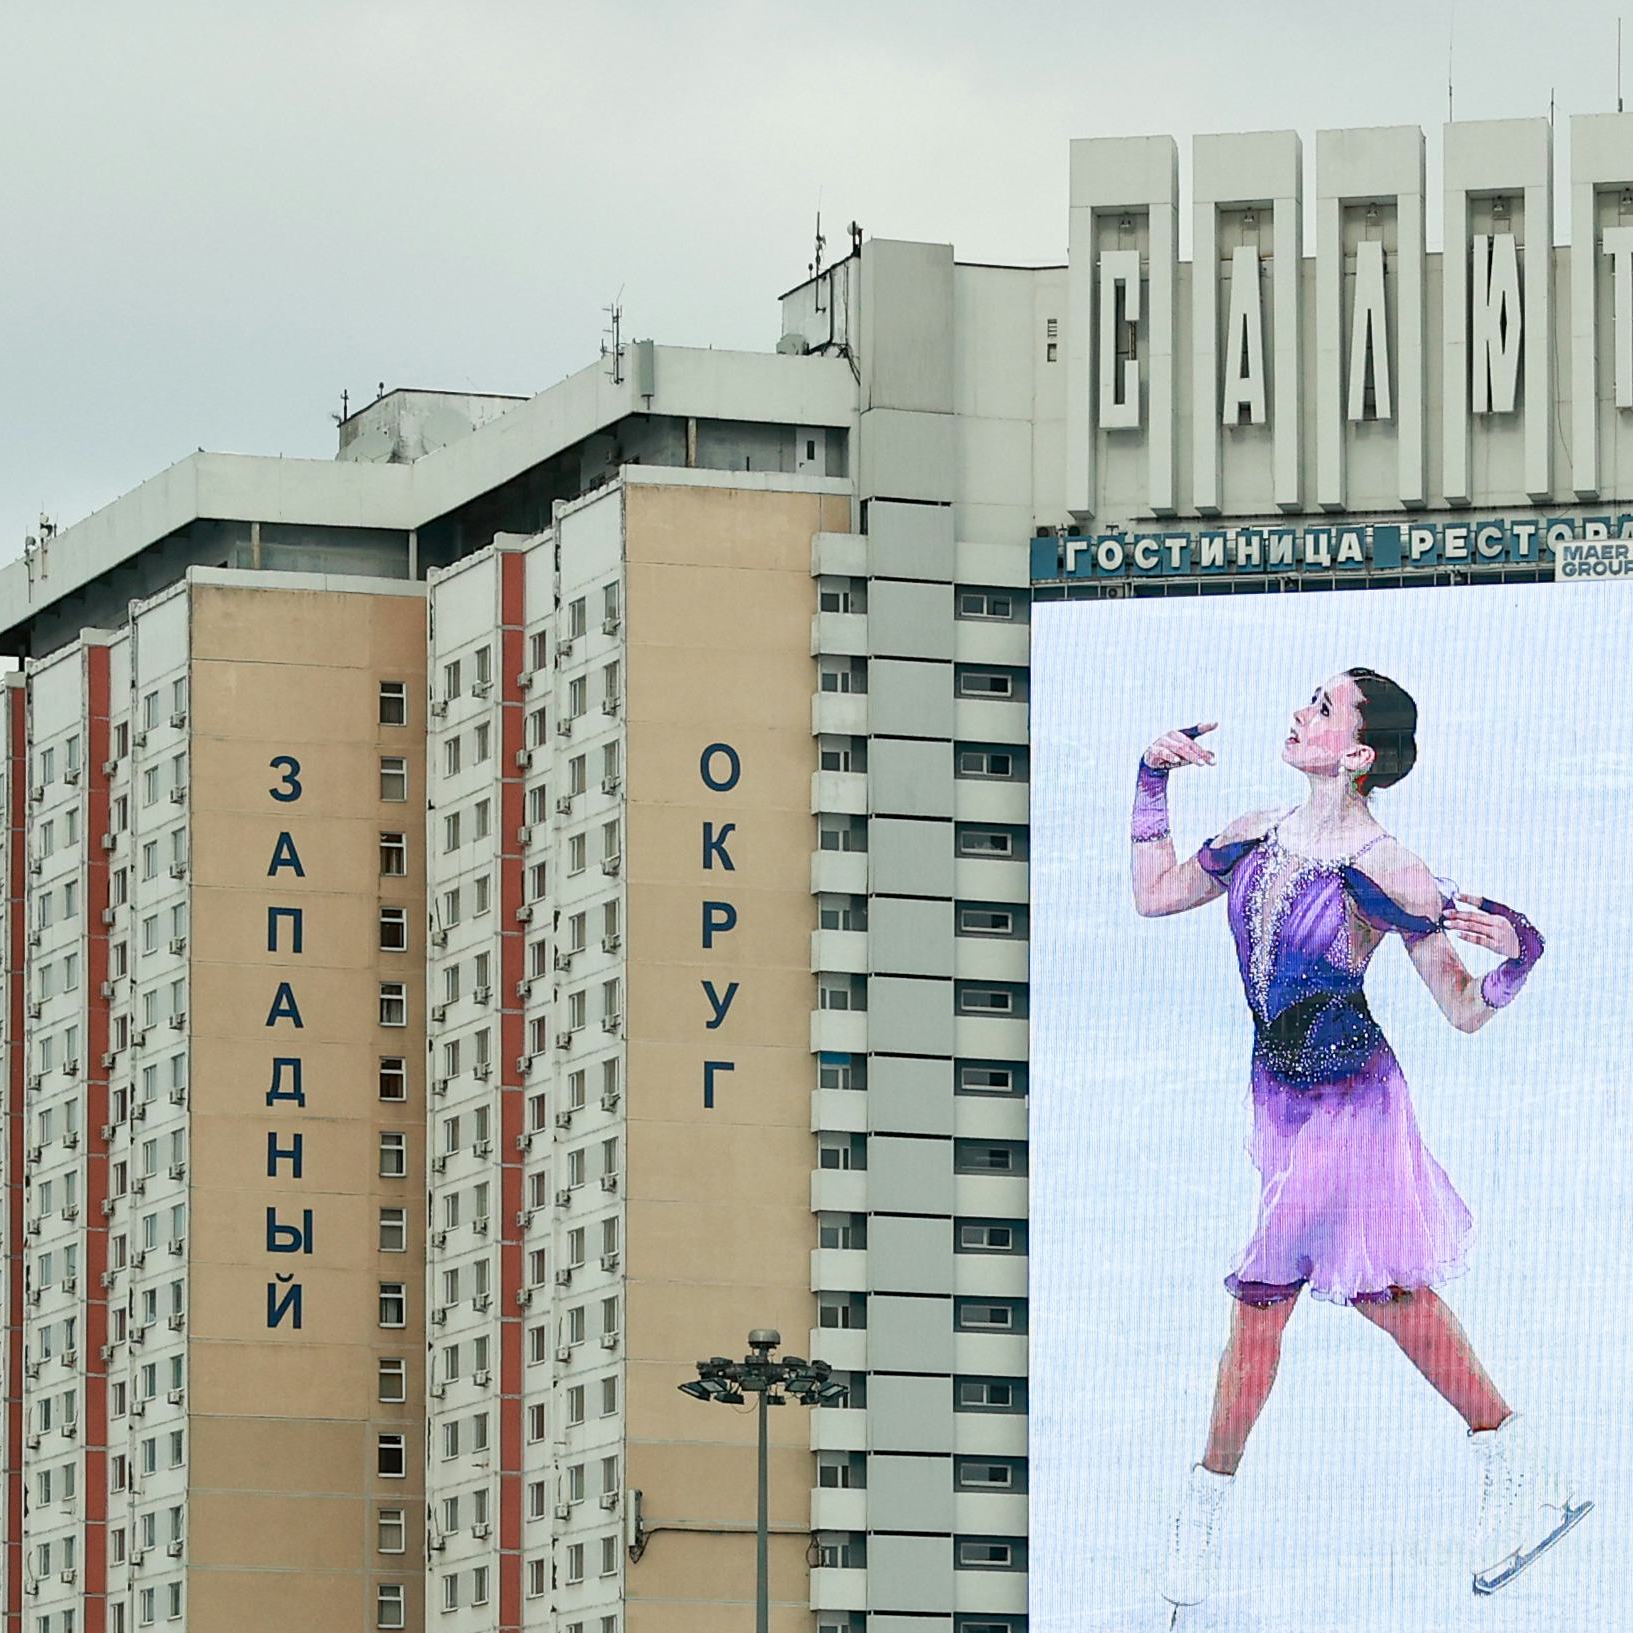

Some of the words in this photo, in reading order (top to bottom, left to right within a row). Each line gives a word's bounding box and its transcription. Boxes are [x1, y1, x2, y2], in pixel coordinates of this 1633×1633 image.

[1066, 531, 1365, 572] ГОСТИНИЦА
[1562, 544, 1630, 561] MAER
[698, 742, 742, 1109] ОКРУГ
[265, 754, 314, 1330] ЗАПАДНЫЙ
